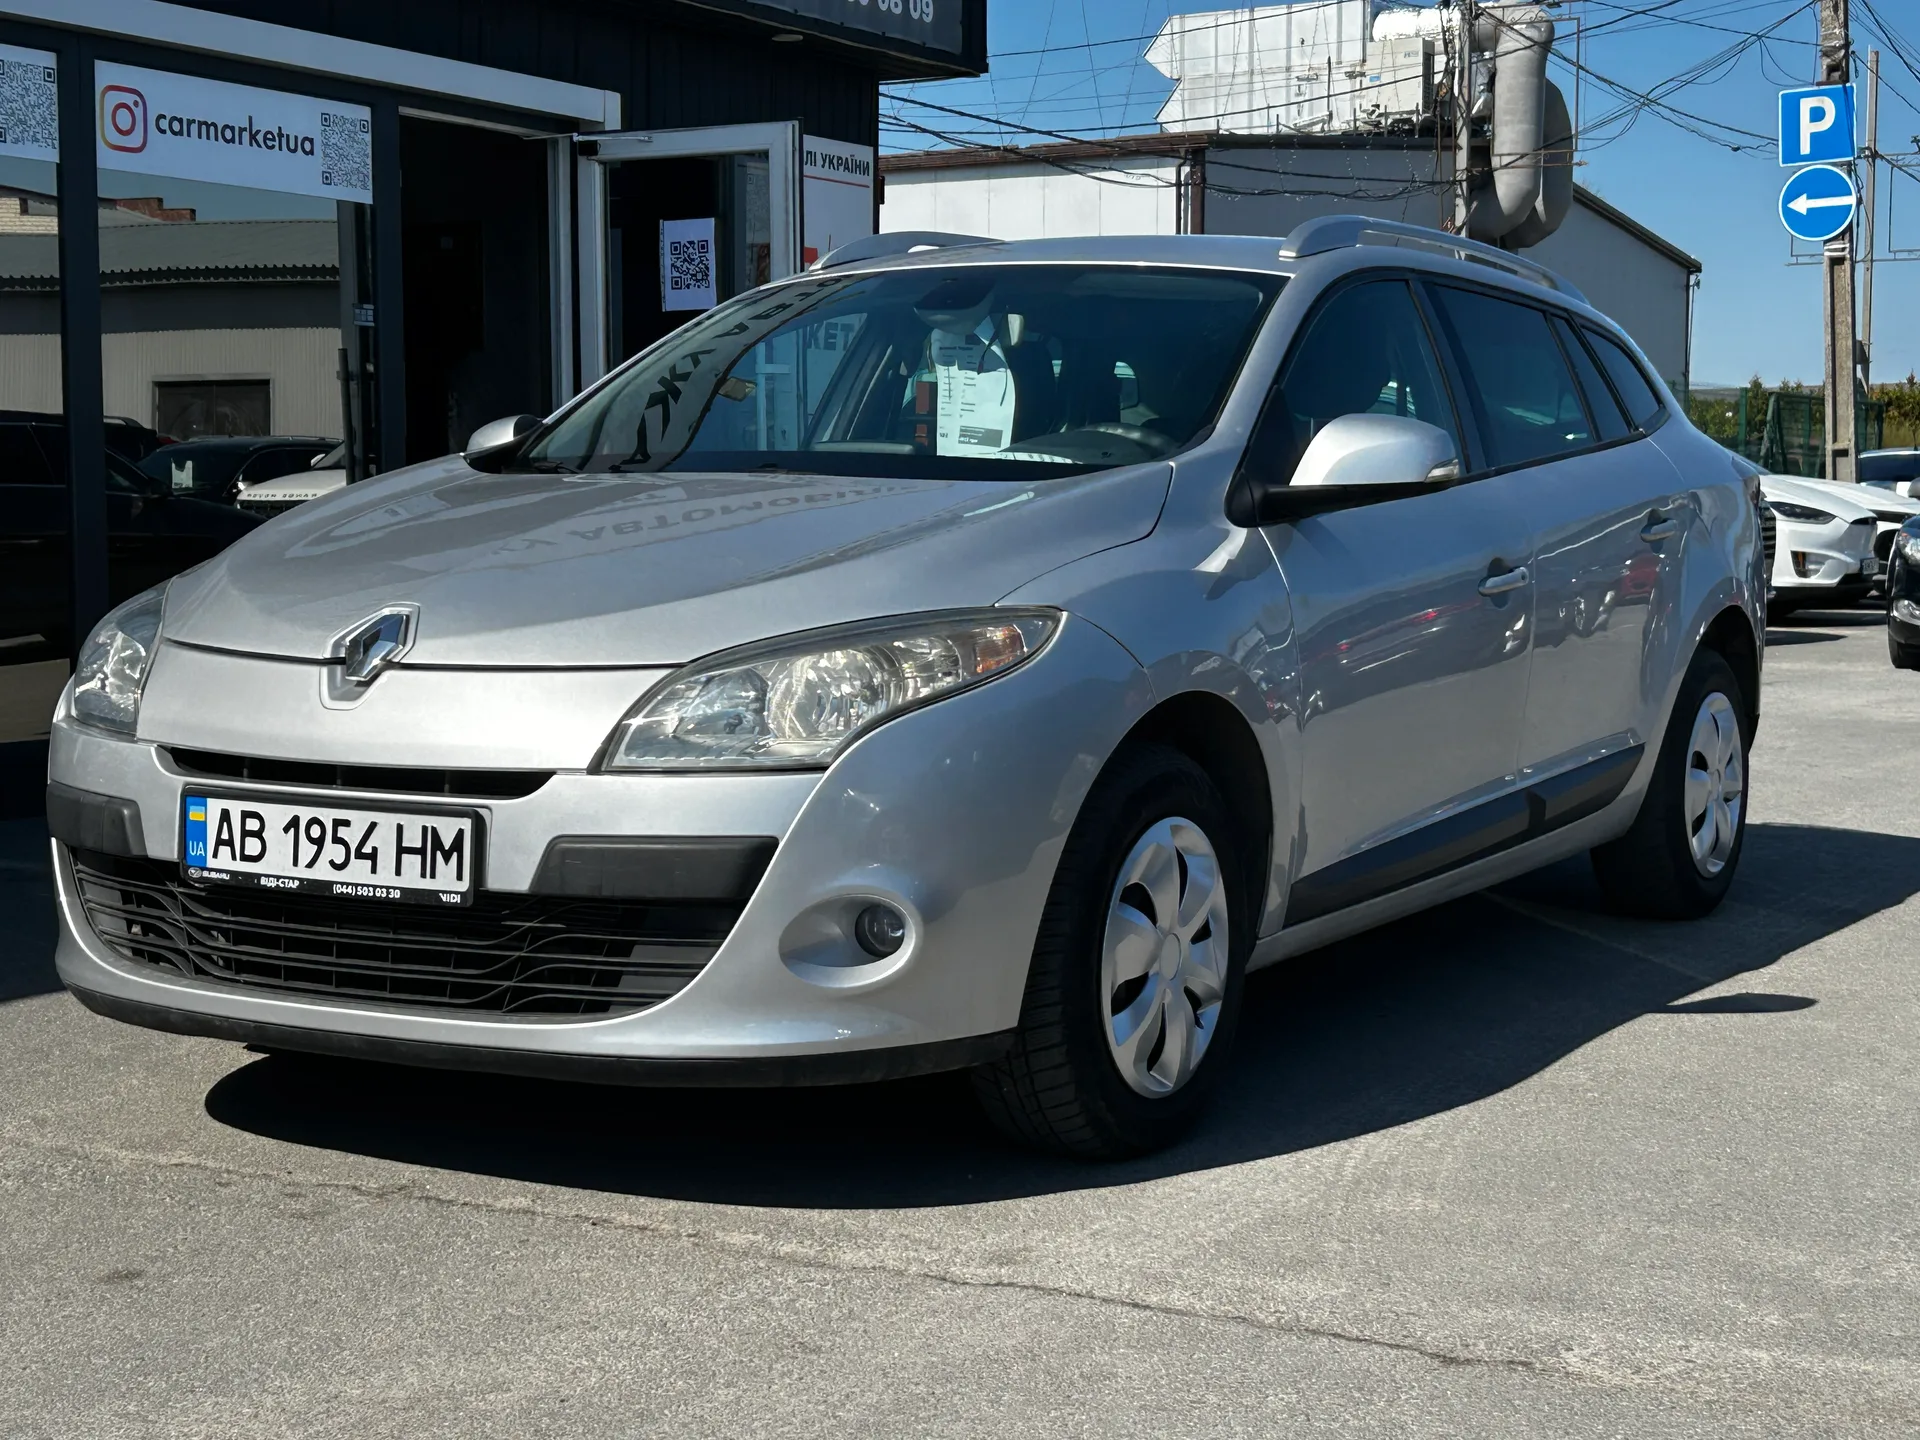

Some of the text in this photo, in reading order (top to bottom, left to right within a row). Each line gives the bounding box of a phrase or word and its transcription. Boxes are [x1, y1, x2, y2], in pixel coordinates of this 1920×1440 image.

[908, 0, 933, 23] 09
[155, 112, 315, 156] carmarketua
[1799, 95, 1836, 156] P
[820, 153, 870, 177] УКРАЇНИ
[188, 839, 206, 858] UA
[211, 807, 466, 882] AB 1954 HM
[333, 883, 401, 899] (044) 503 03 30
[438, 892, 461, 904] VIDI
